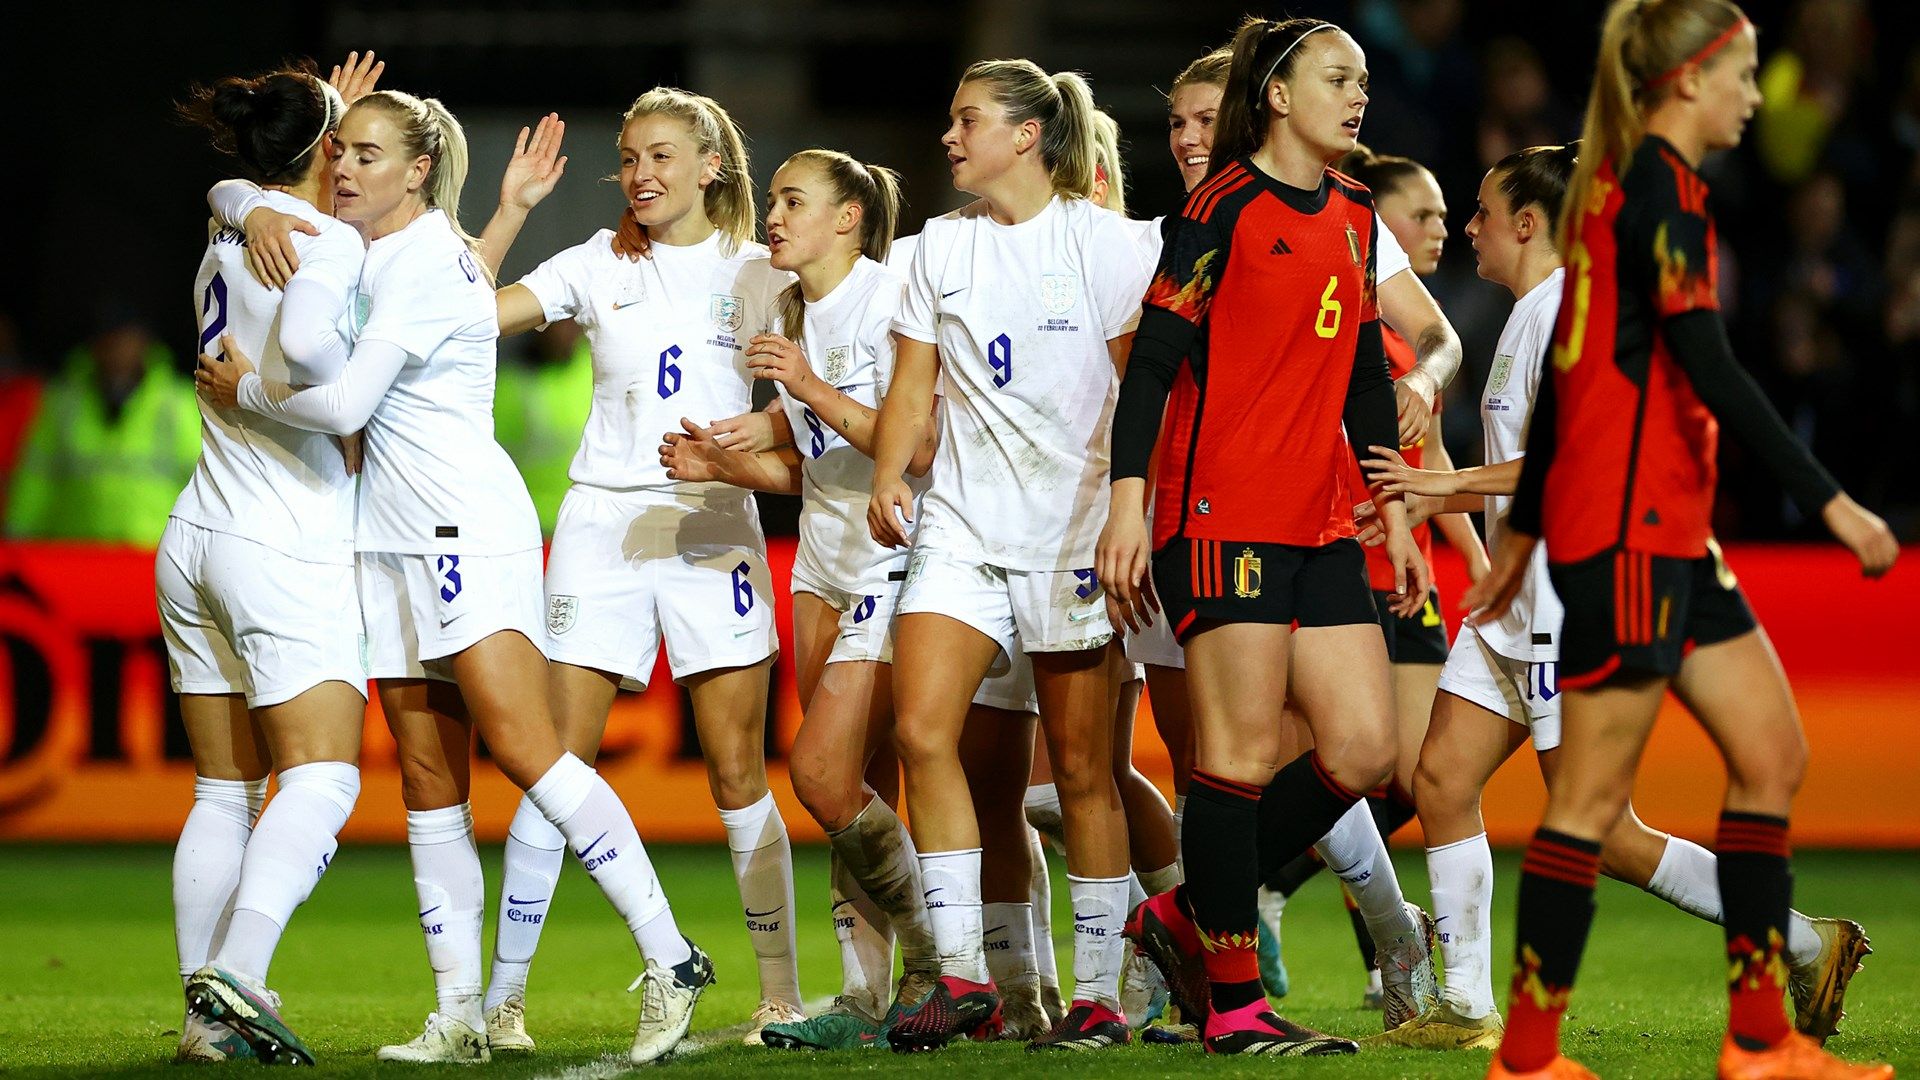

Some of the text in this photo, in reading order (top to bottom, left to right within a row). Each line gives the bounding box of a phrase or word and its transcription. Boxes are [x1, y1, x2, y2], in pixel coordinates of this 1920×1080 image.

[200, 271, 228, 362] 2
[1314, 276, 1342, 338] 6
[657, 344, 683, 400] 6
[988, 333, 1012, 388] 9
[803, 406, 826, 460] 8
[437, 554, 463, 604] 3
[731, 560, 754, 618] 6
[585, 847, 618, 871] Eng
[420, 922, 444, 936] ng
[507, 908, 543, 925] Eng
[746, 920, 781, 932] Eng
[832, 916, 856, 930] ng
[1074, 923, 1107, 937] Eng
